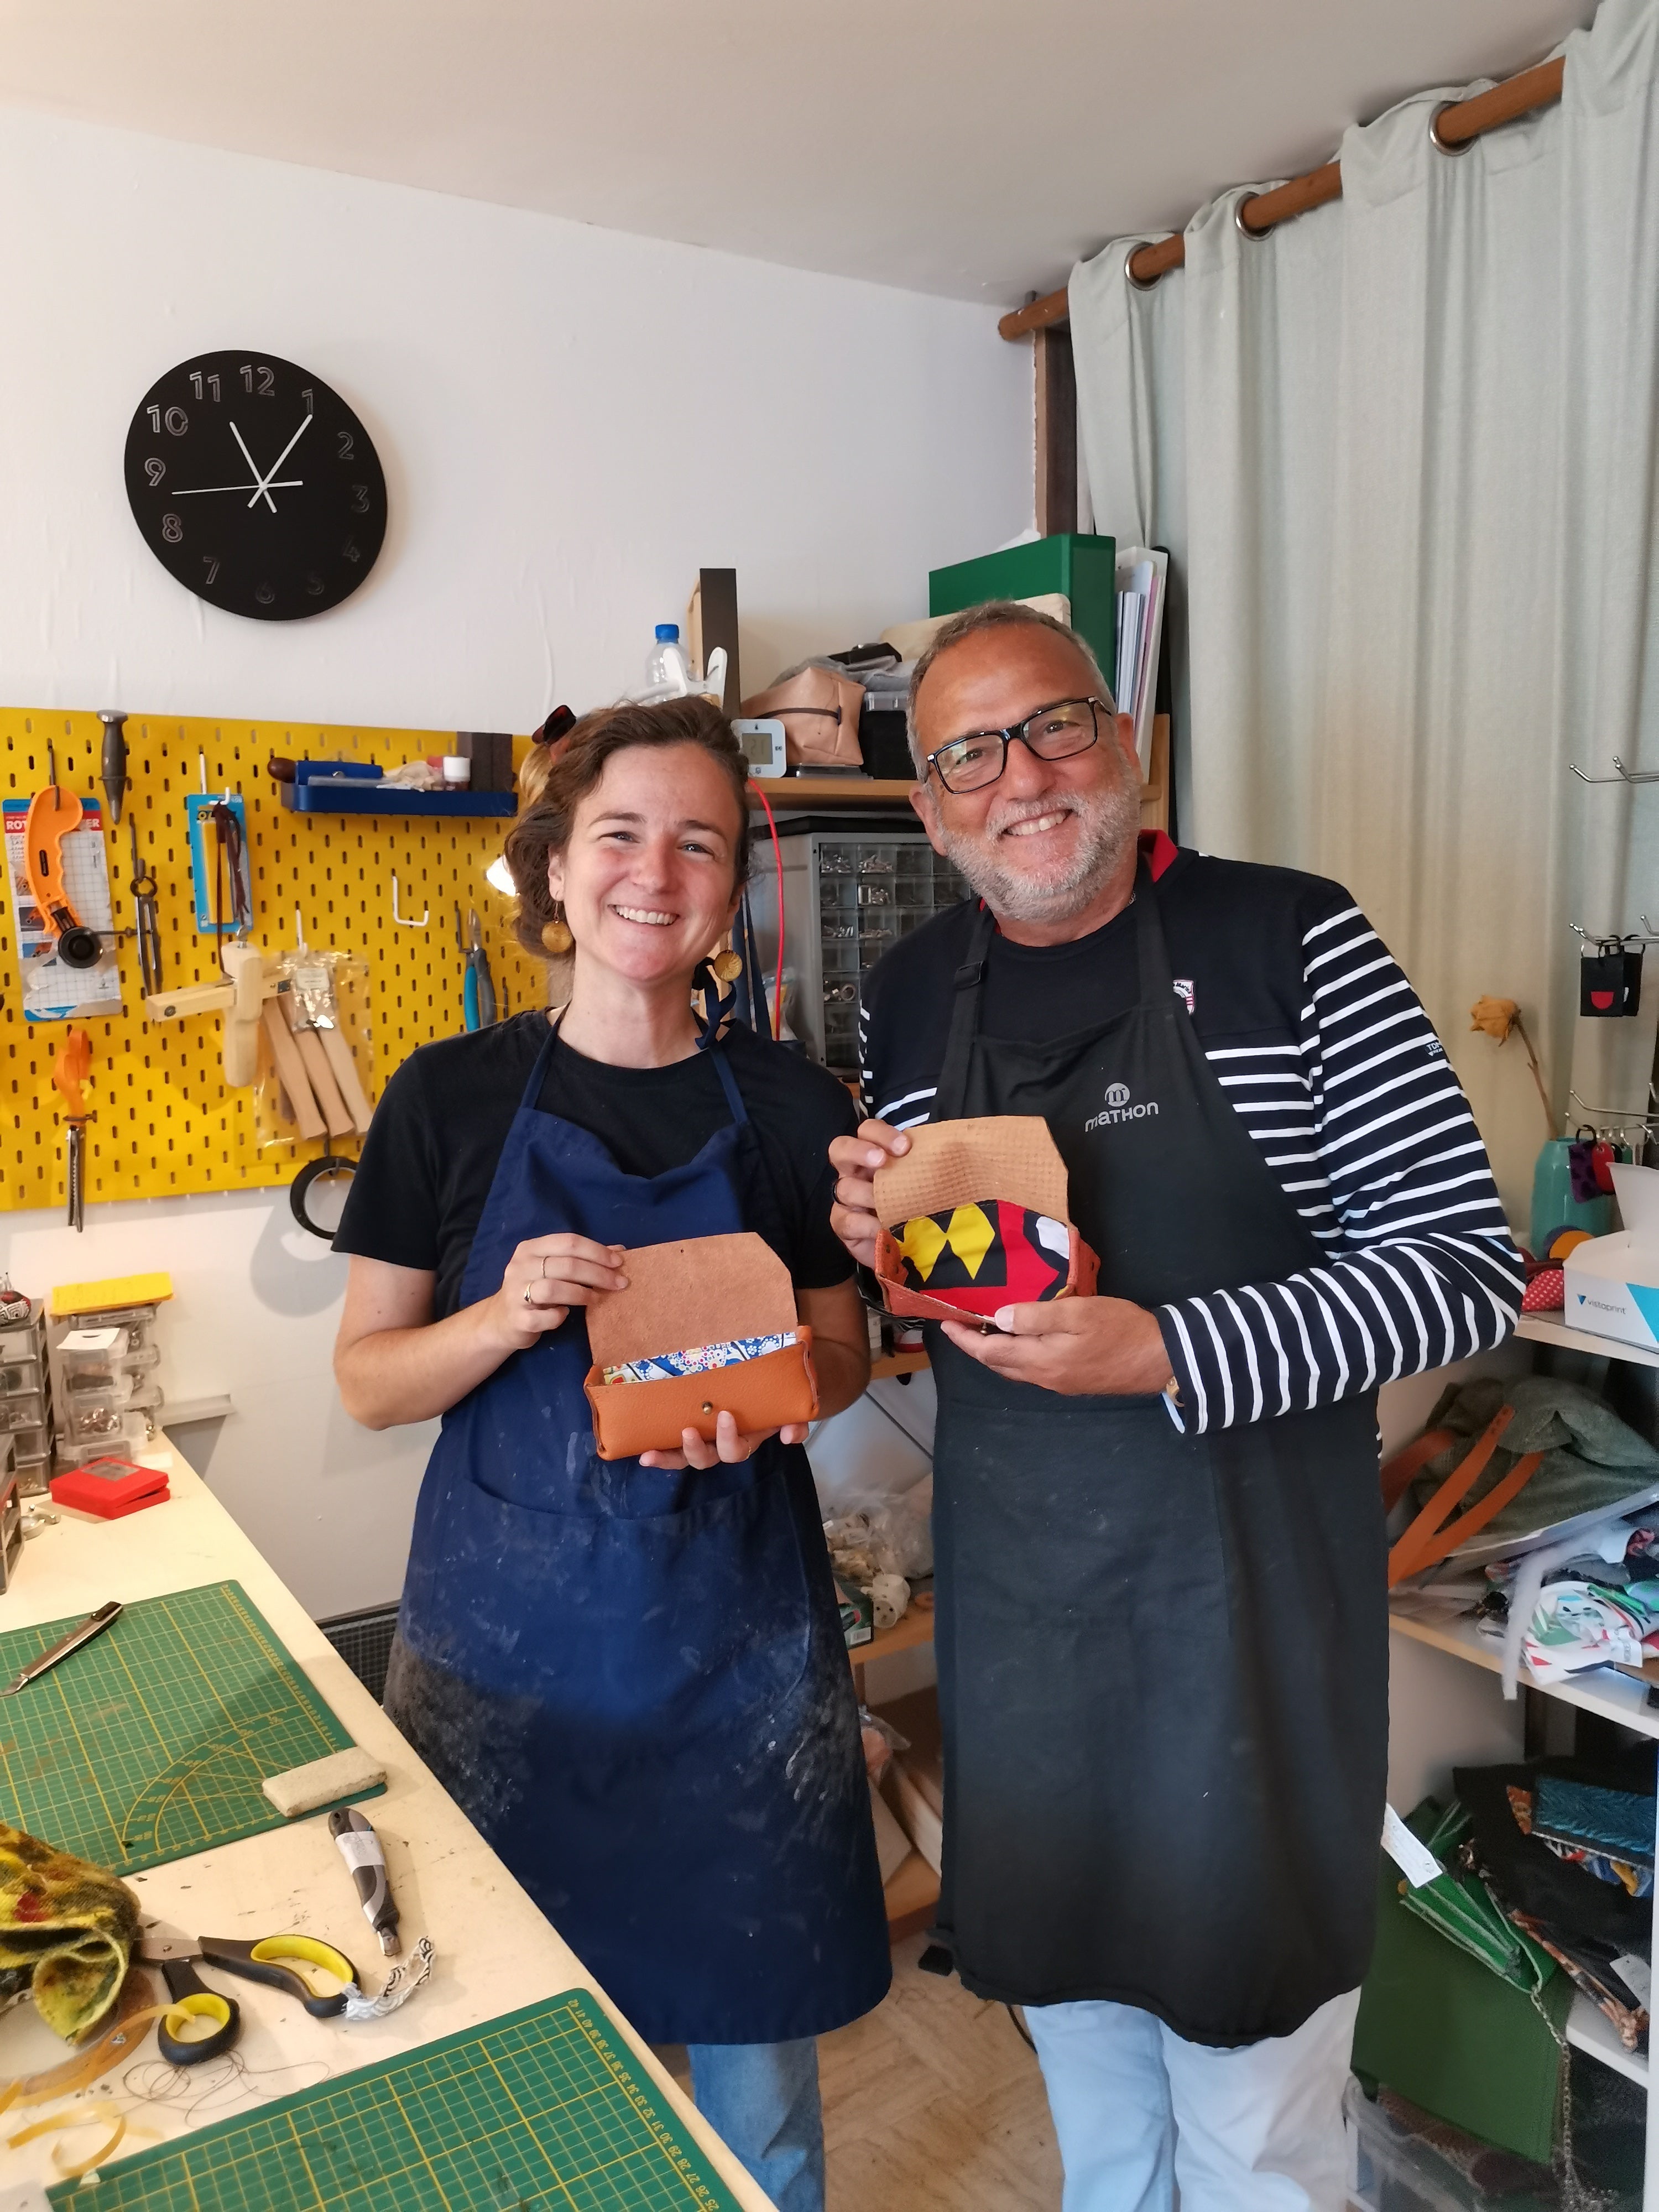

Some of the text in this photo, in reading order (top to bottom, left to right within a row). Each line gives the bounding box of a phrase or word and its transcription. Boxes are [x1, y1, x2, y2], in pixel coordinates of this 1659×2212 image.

[190, 371, 221, 402] 11
[240, 365, 275, 396] 12
[302, 389, 314, 416] 1
[147, 404, 189, 436] 10
[337, 431, 354, 460] 2
[144, 458, 166, 487] 9
[352, 484, 370, 513] 3
[162, 513, 183, 543] 8
[204, 556, 221, 585] 7
[255, 581, 275, 604] 6
[1587, 1300, 1626, 1314] vistaprint
[603, 2052, 616, 2060] 37
[619, 2072, 632, 2083] 35
[627, 2084, 640, 2094] 34
[634, 2095, 648, 2106] 33
[643, 2107, 656, 2119] 32
[651, 2121, 664, 2131] 31
[660, 2132, 673, 2143] 30
[668, 2145, 682, 2157] 29
[677, 2158, 691, 2170] 28
[686, 2173, 701, 2184] 27
[695, 2185, 709, 2198] 26
